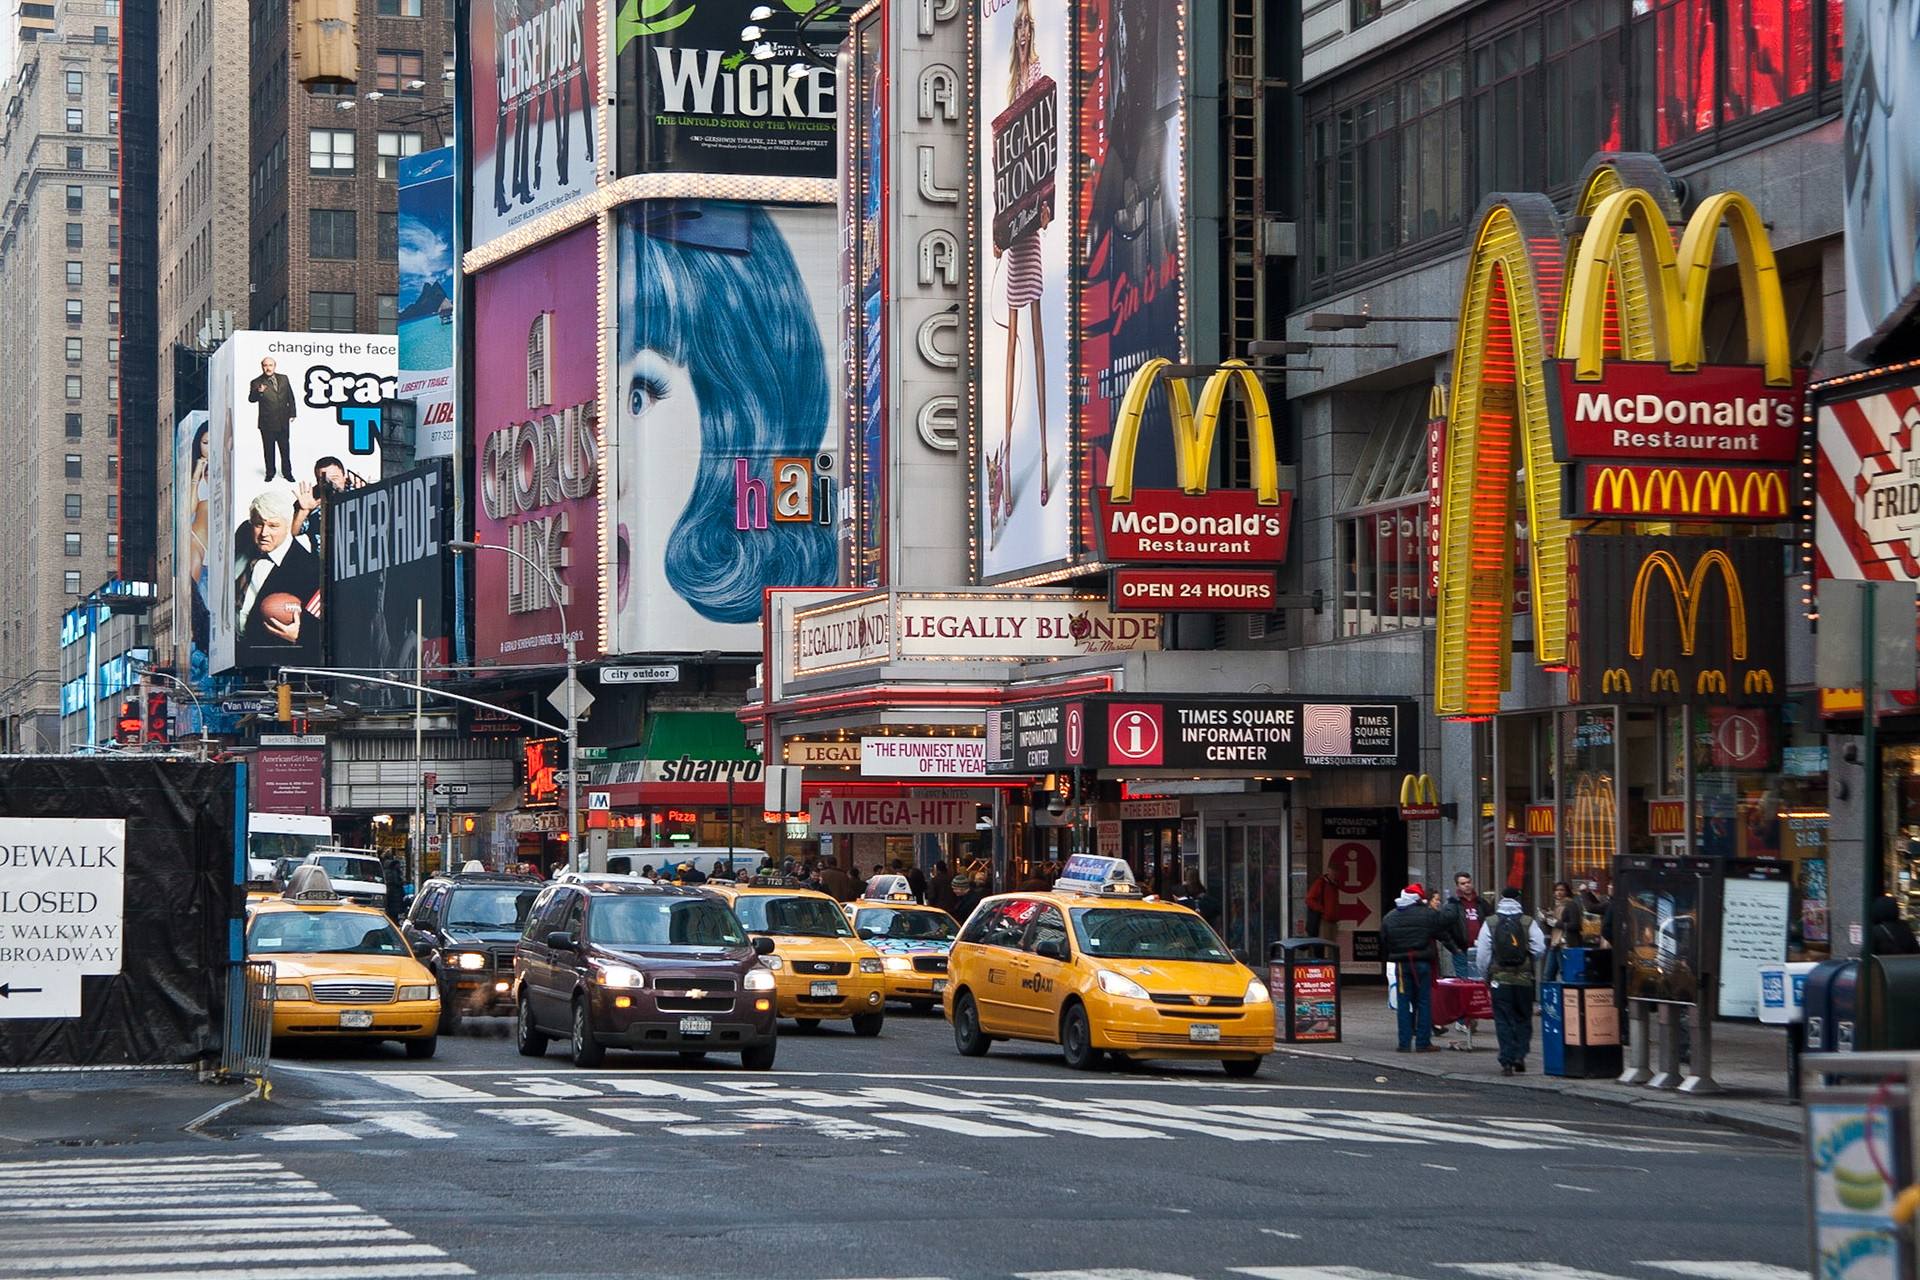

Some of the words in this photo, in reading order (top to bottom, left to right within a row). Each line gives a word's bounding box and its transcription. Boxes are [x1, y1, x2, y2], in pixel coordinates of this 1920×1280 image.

[501, 10, 548, 103] JERSEY
[550, 0, 582, 76] BOYS
[656, 115, 677, 126] THE
[678, 117, 719, 128] UNTOLD
[721, 118, 751, 129] STORY
[753, 121, 766, 129] OF
[767, 121, 785, 131] THE
[787, 121, 830, 132] WITCHES
[704, 135, 736, 144] GERSHWIN
[996, 90, 1057, 174] LEGALLY
[997, 135, 1057, 215] BLONDE
[917, 0, 960, 452] PALACE
[1112, 271, 1139, 336] Sin
[1144, 263, 1156, 304] is
[269, 341, 334, 357] changing
[340, 342, 361, 355] the
[367, 343, 396, 356] face
[527, 313, 552, 410] A
[400, 379, 427, 393] LIBERTY
[427, 376, 450, 389] TRAVEL
[1575, 392, 1795, 428] McDonald's
[341, 407, 381, 450] T
[1613, 429, 1760, 451] Restaurant
[481, 400, 598, 521] CHORUS
[1431, 430, 1439, 490] OPEN
[1431, 496, 1441, 508] 24
[334, 489, 391, 583] NEVER
[398, 471, 438, 566] HIDE
[1111, 511, 1281, 537] McDonald's
[1138, 538, 1252, 553] Restaurant
[1431, 515, 1440, 588] HOURS
[508, 511, 569, 615] LINE
[1122, 583, 1174, 598] OPEN
[1180, 583, 1203, 598] 24
[1208, 583, 1272, 599] HOURS
[802, 622, 845, 658] LEGALLY
[846, 613, 889, 651] BLONDE
[904, 616, 1027, 639] LEGALLY
[1036, 615, 1157, 641] BLONDE
[1083, 640, 1098, 654] The
[1100, 638, 1138, 652] Musical
[611, 670, 631, 680] city
[633, 668, 670, 679] outdoor
[228, 702, 241, 711] Van
[1019, 710, 1036, 727] TIMES
[1036, 706, 1059, 728] SQUARE
[1178, 709, 1228, 725] TIMES
[1232, 709, 1295, 727] SQUARE
[1357, 716, 1389, 726] TIMES
[1020, 728, 1058, 748] INFORMATION
[1182, 728, 1291, 743] INFORMATION
[1354, 727, 1392, 738] SQUARE
[1356, 738, 1389, 746] ALLIANCE
[262, 754, 291, 763] American
[806, 747, 861, 761] LEGAL
[867, 743, 896, 757] "THE
[900, 743, 952, 757] FUNNIEST
[956, 744, 983, 758] NEW
[1028, 749, 1049, 766] CENTER
[1206, 745, 1267, 761] CENTER
[659, 754, 762, 783] sbarro
[919, 759, 933, 772] OF
[936, 759, 958, 772] THE
[960, 759, 987, 773] YEAR
[1304, 757, 1397, 766] TIMESSQUARENYC.ORG
[669, 811, 697, 823] Pizza
[763, 811, 791, 823] Pasa
[1143, 803, 1160, 817] BEST
[1161, 803, 1179, 816] NEW
[1325, 817, 1379, 827] INFORMATION
[1336, 827, 1367, 836] CENTER
[429, 836, 439, 845] 10
[767, 878, 783, 886] 7T20
[307, 891, 328, 900] 6H85
[12, 924, 120, 939] WALKWAY.
[1, 947, 118, 962] BROADWAY
